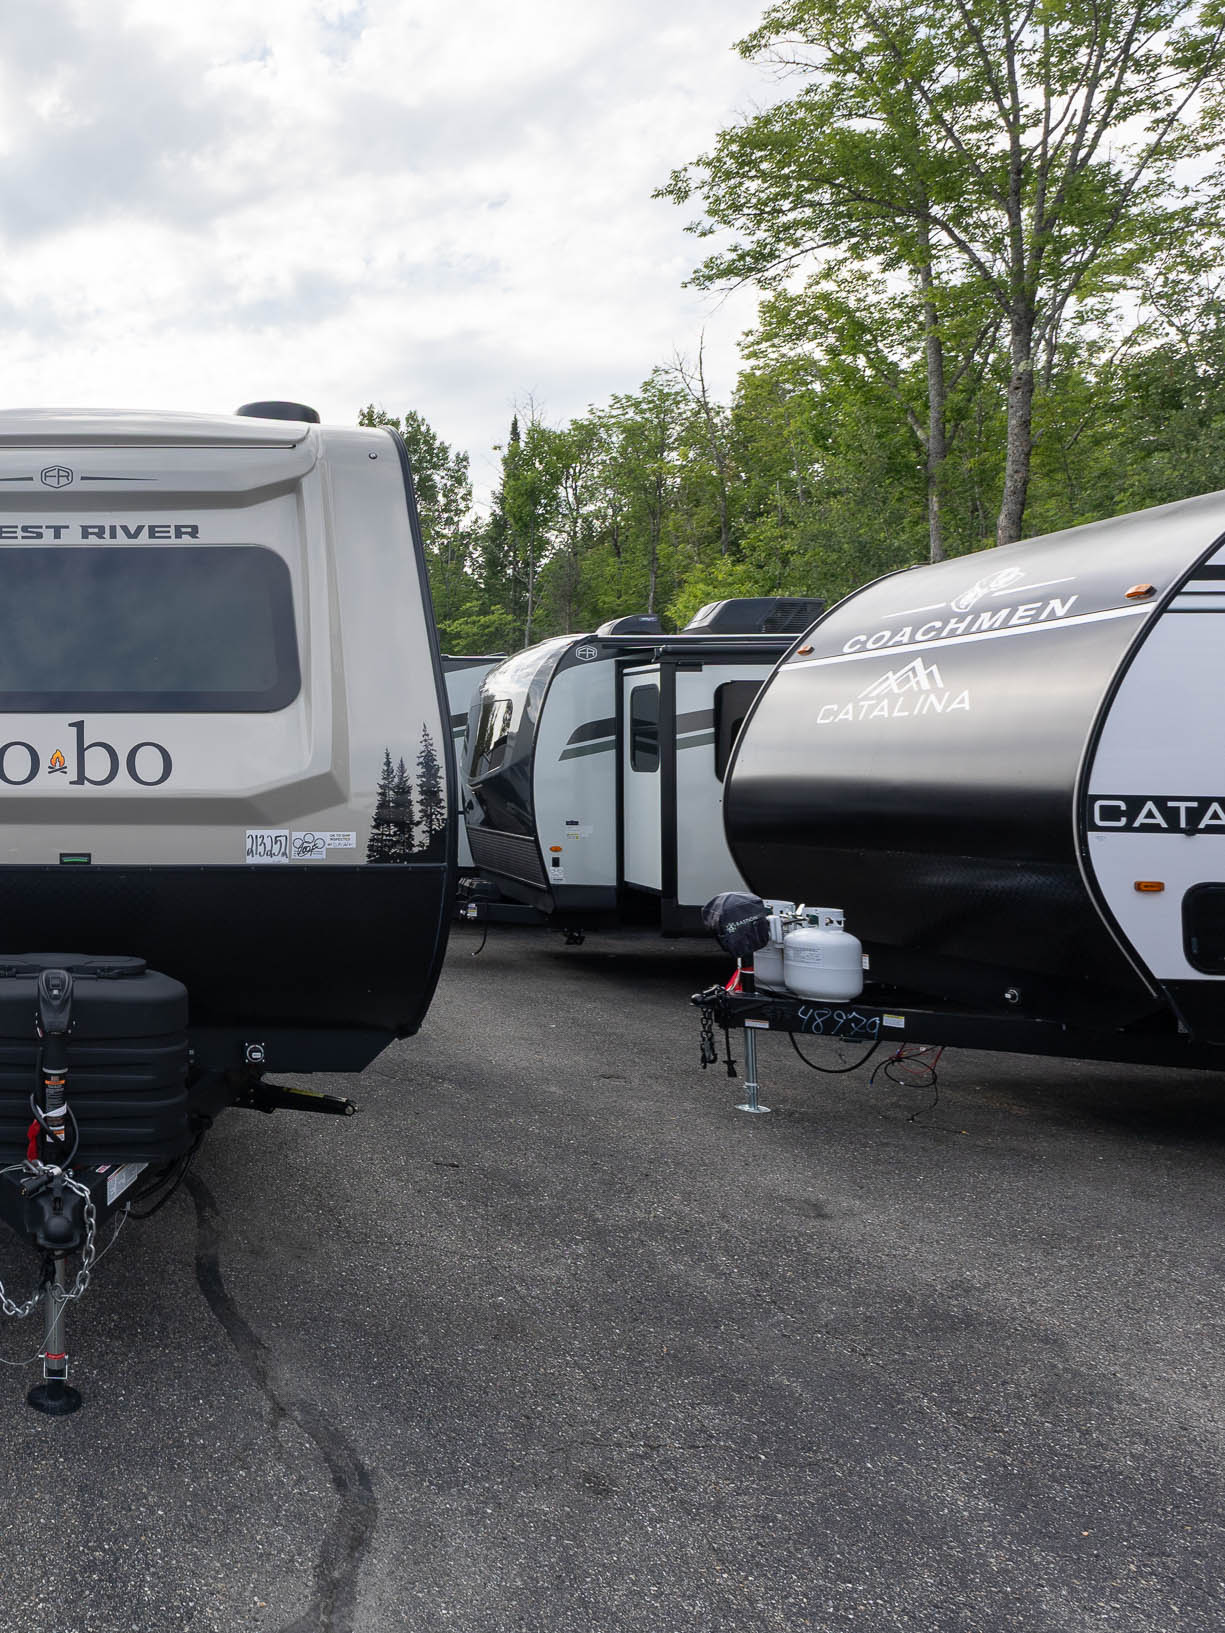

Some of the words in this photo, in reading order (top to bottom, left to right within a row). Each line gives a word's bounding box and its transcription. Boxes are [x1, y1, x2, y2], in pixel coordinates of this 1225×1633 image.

[80, 524, 201, 540] RIVER
[842, 595, 1078, 653] COACHMEN
[816, 689, 970, 724] CATALINA
[1093, 800, 1225, 828] CATA
